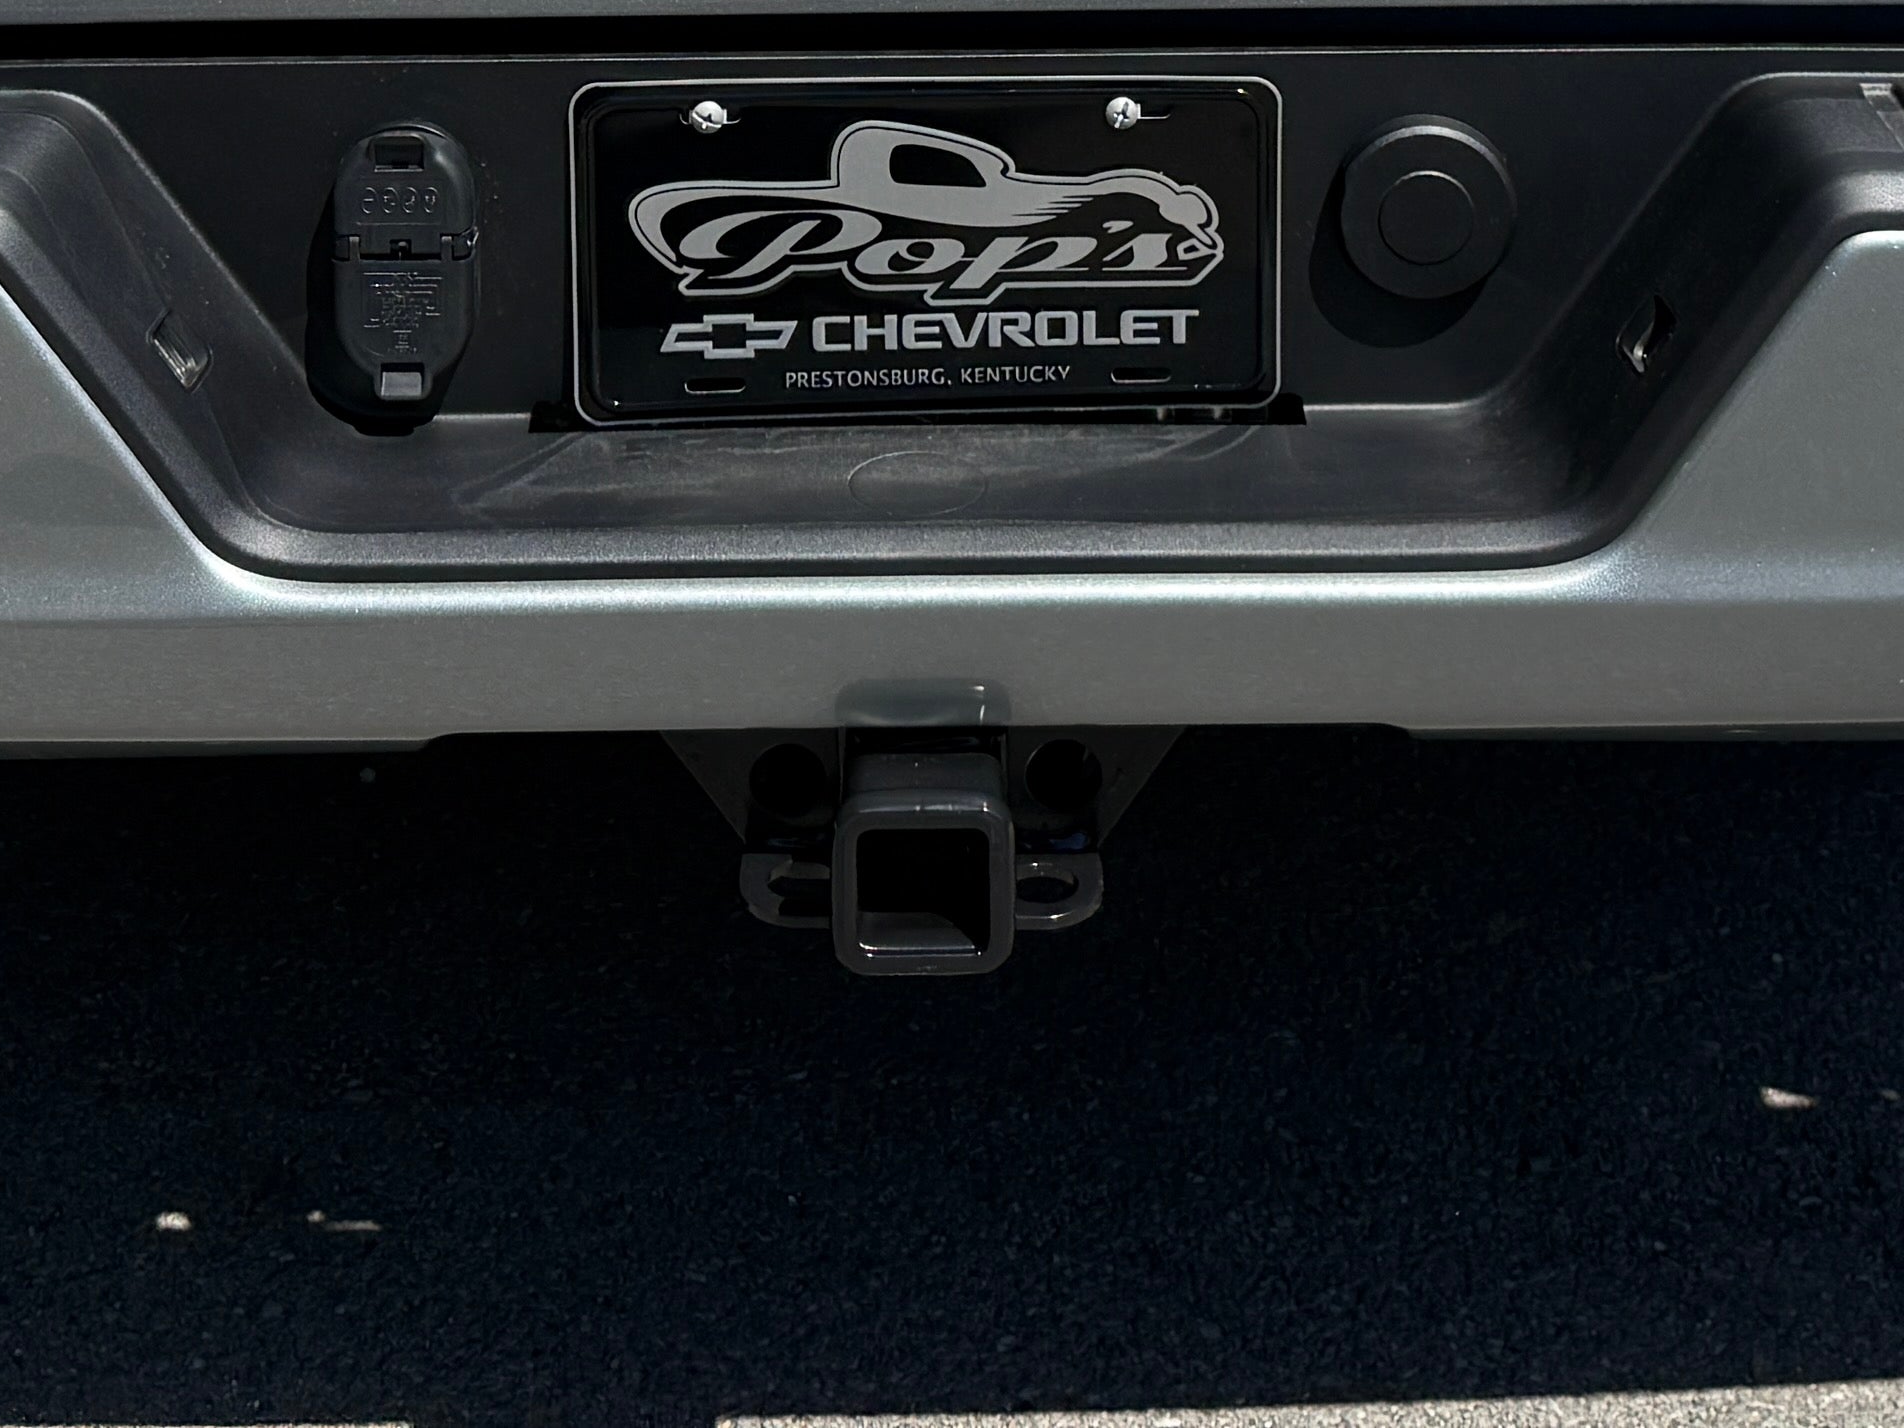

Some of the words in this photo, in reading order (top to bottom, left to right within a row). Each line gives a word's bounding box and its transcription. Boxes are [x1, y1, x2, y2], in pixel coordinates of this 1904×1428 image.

[680, 208, 1190, 290] Pop's
[811, 309, 1199, 352] CHEVROLET
[785, 368, 953, 389] PRESTONSBURG,
[960, 365, 1071, 385] KENTUCKY
